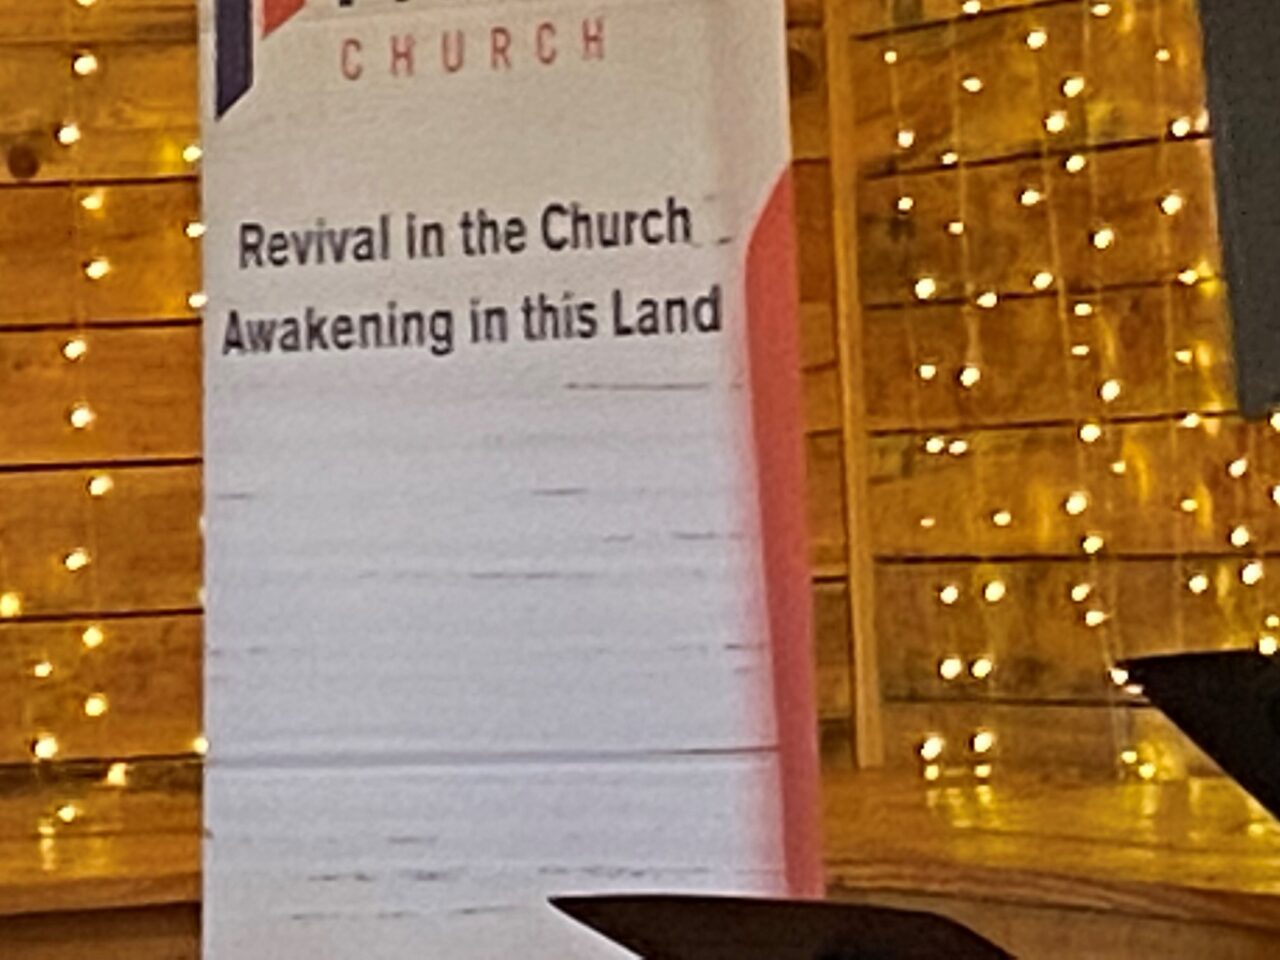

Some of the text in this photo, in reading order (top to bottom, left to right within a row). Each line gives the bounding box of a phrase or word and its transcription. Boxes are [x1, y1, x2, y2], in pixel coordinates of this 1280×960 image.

[340, 18, 606, 81] CHURCH
[238, 196, 693, 269] Revival in the Church
[221, 283, 723, 356] Awakening in this Land
